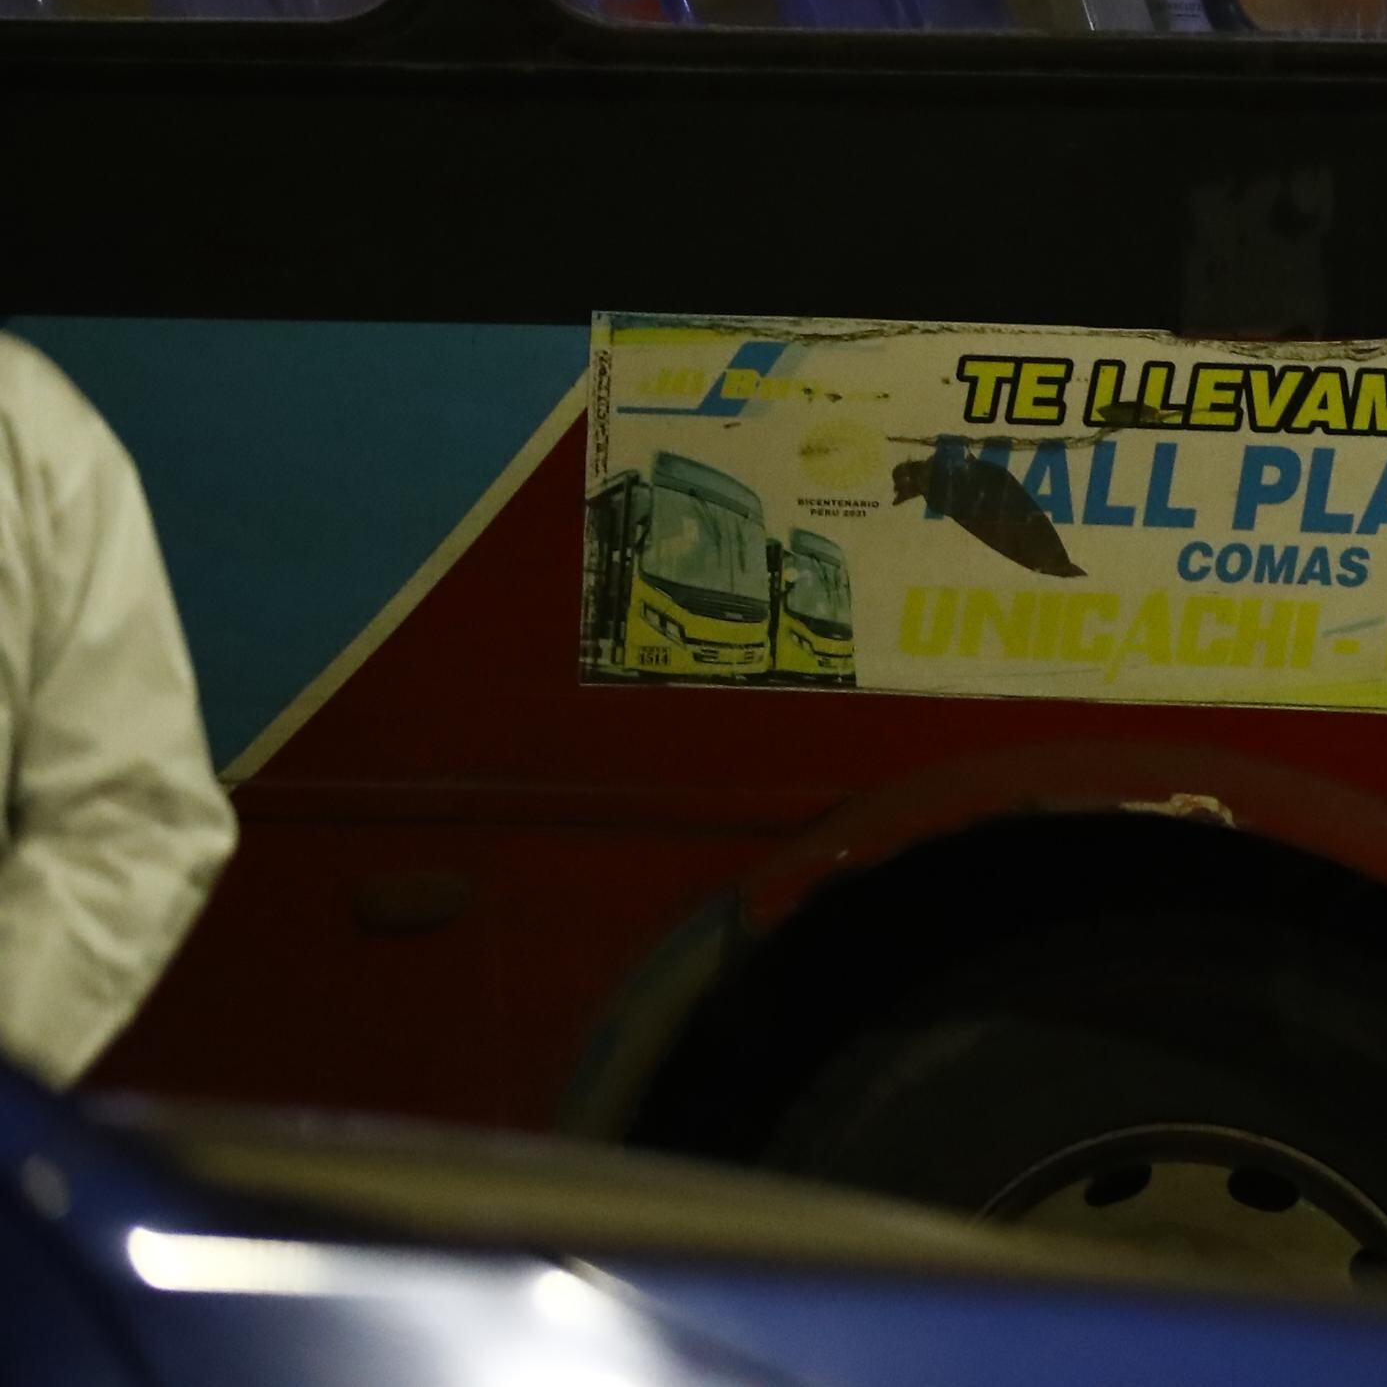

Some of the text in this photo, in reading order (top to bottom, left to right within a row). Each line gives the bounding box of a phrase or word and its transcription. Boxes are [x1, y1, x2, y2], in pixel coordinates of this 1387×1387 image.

[957, 352, 1075, 426] TE
[798, 498, 880, 509] BICENTENARIO
[1177, 539, 1371, 589] COMAS
[897, 584, 1317, 683] UNICACHI
